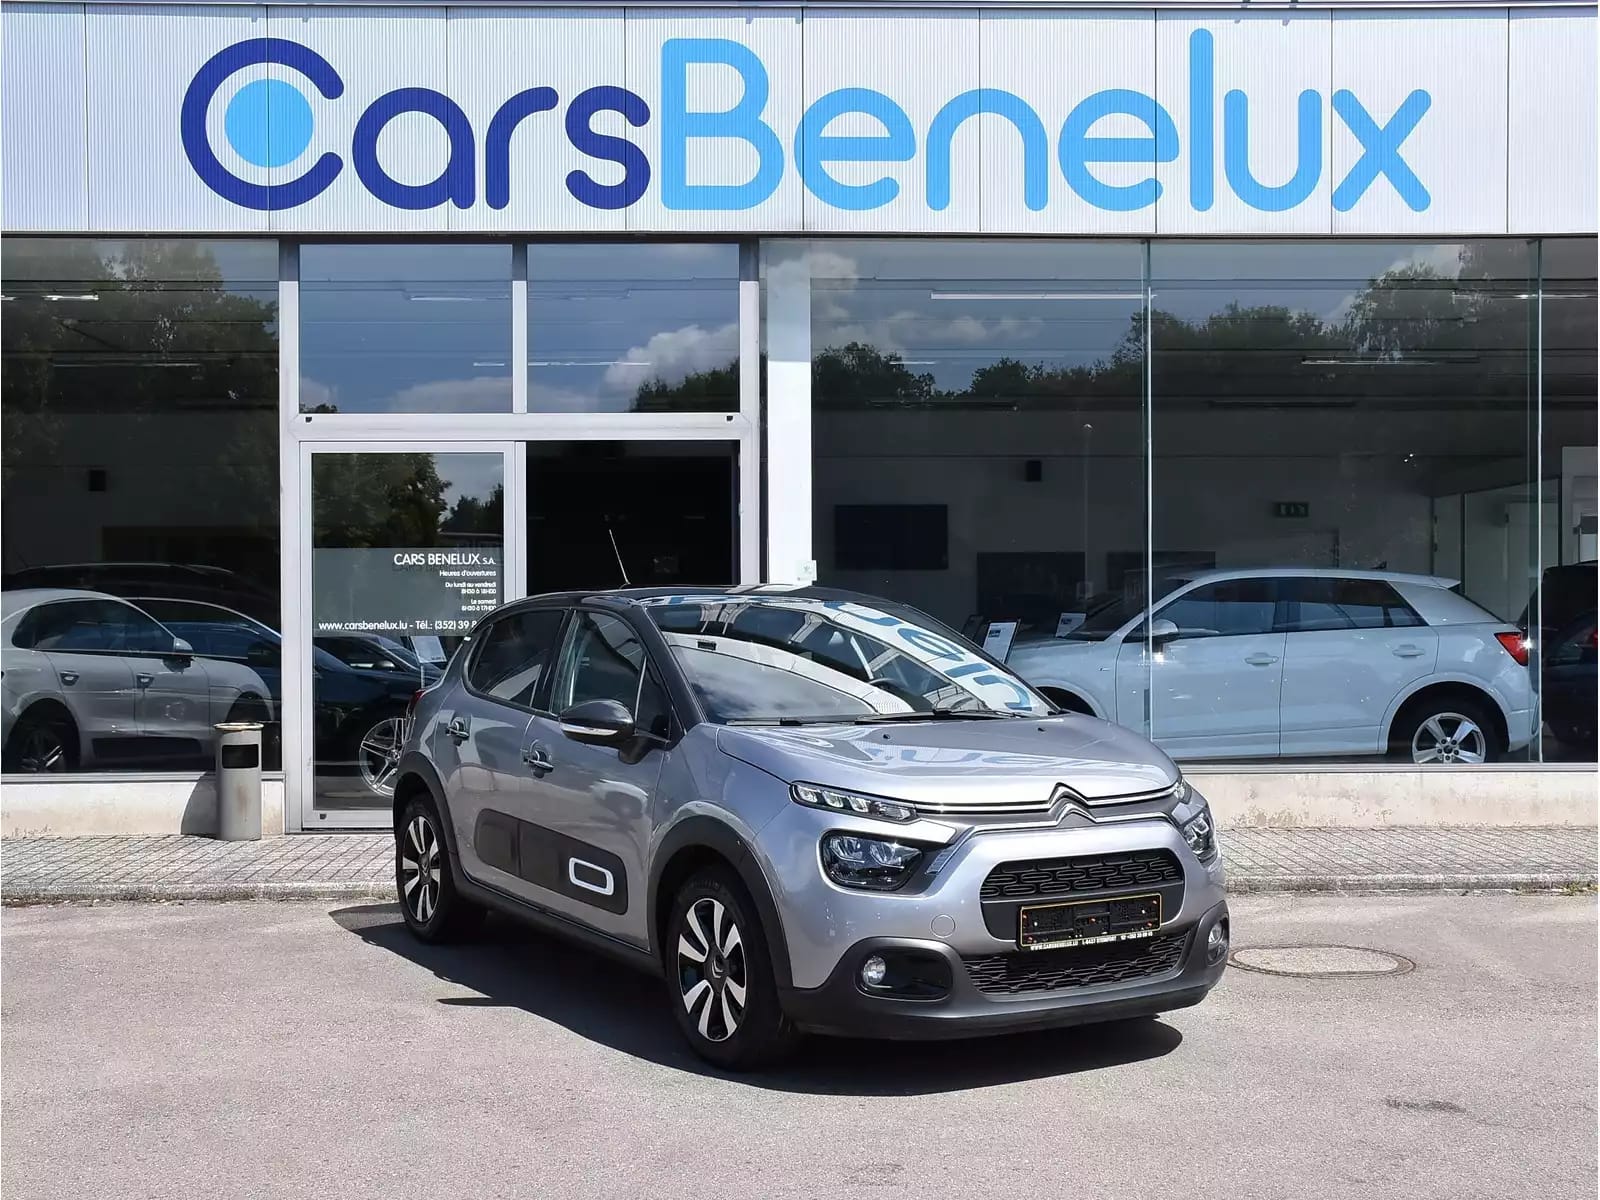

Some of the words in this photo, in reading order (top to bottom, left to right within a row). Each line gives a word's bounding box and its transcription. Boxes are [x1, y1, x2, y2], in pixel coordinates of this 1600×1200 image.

[393, 553, 425, 565] CARS
[428, 553, 480, 565] BENELUX
[482, 557, 497, 565] S.A.
[461, 569, 497, 577] d'ouvertures
[318, 620, 408, 631] www.carsbenelux.lu
[434, 620, 456, 631] (352)
[457, 620, 470, 630] 39
